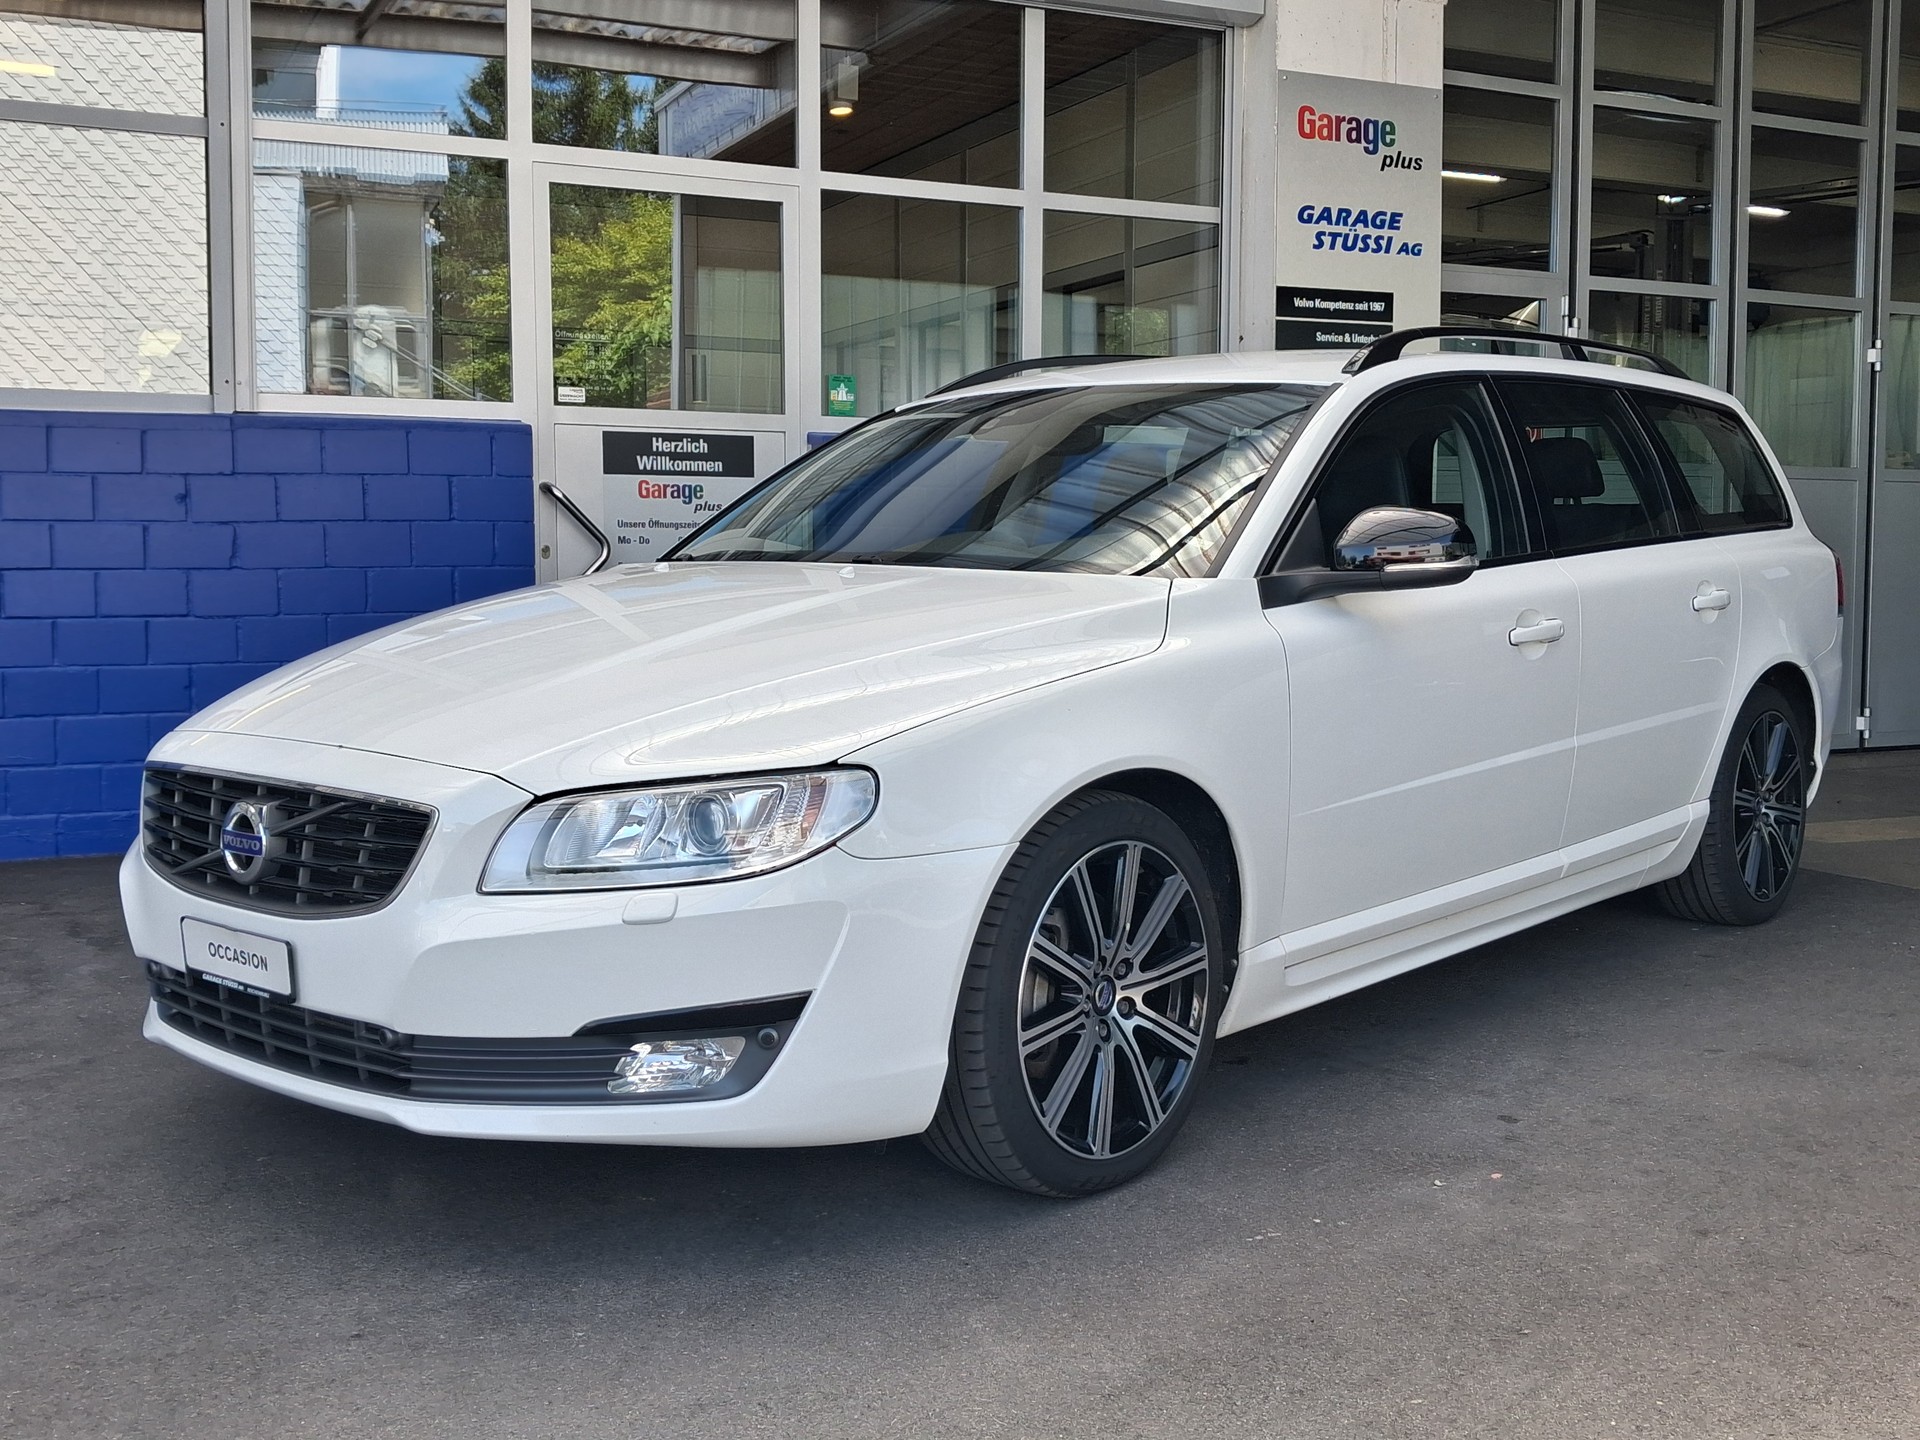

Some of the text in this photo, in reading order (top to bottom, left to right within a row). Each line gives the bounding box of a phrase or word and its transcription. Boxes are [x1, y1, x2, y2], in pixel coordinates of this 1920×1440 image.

[1297, 105, 1396, 155] Garage
[1380, 151, 1423, 171] plus
[1297, 205, 1403, 231] GARAGE
[1312, 228, 1423, 256] STÜSSI AG
[1294, 297, 1385, 312] Volvo Kompetenz seit 1967
[1316, 332, 1343, 343] Service
[1344, 333, 1351, 343] &
[652, 437, 708, 454] Herzlich
[636, 455, 723, 472] Willkommen
[637, 479, 704, 505] Garage
[693, 501, 722, 514] plus
[617, 520, 646, 529] Unsere
[618, 536, 631, 544] Mo
[639, 536, 650, 544] Do
[223, 834, 260, 851] VOLVO
[208, 941, 268, 972] OCCASION
